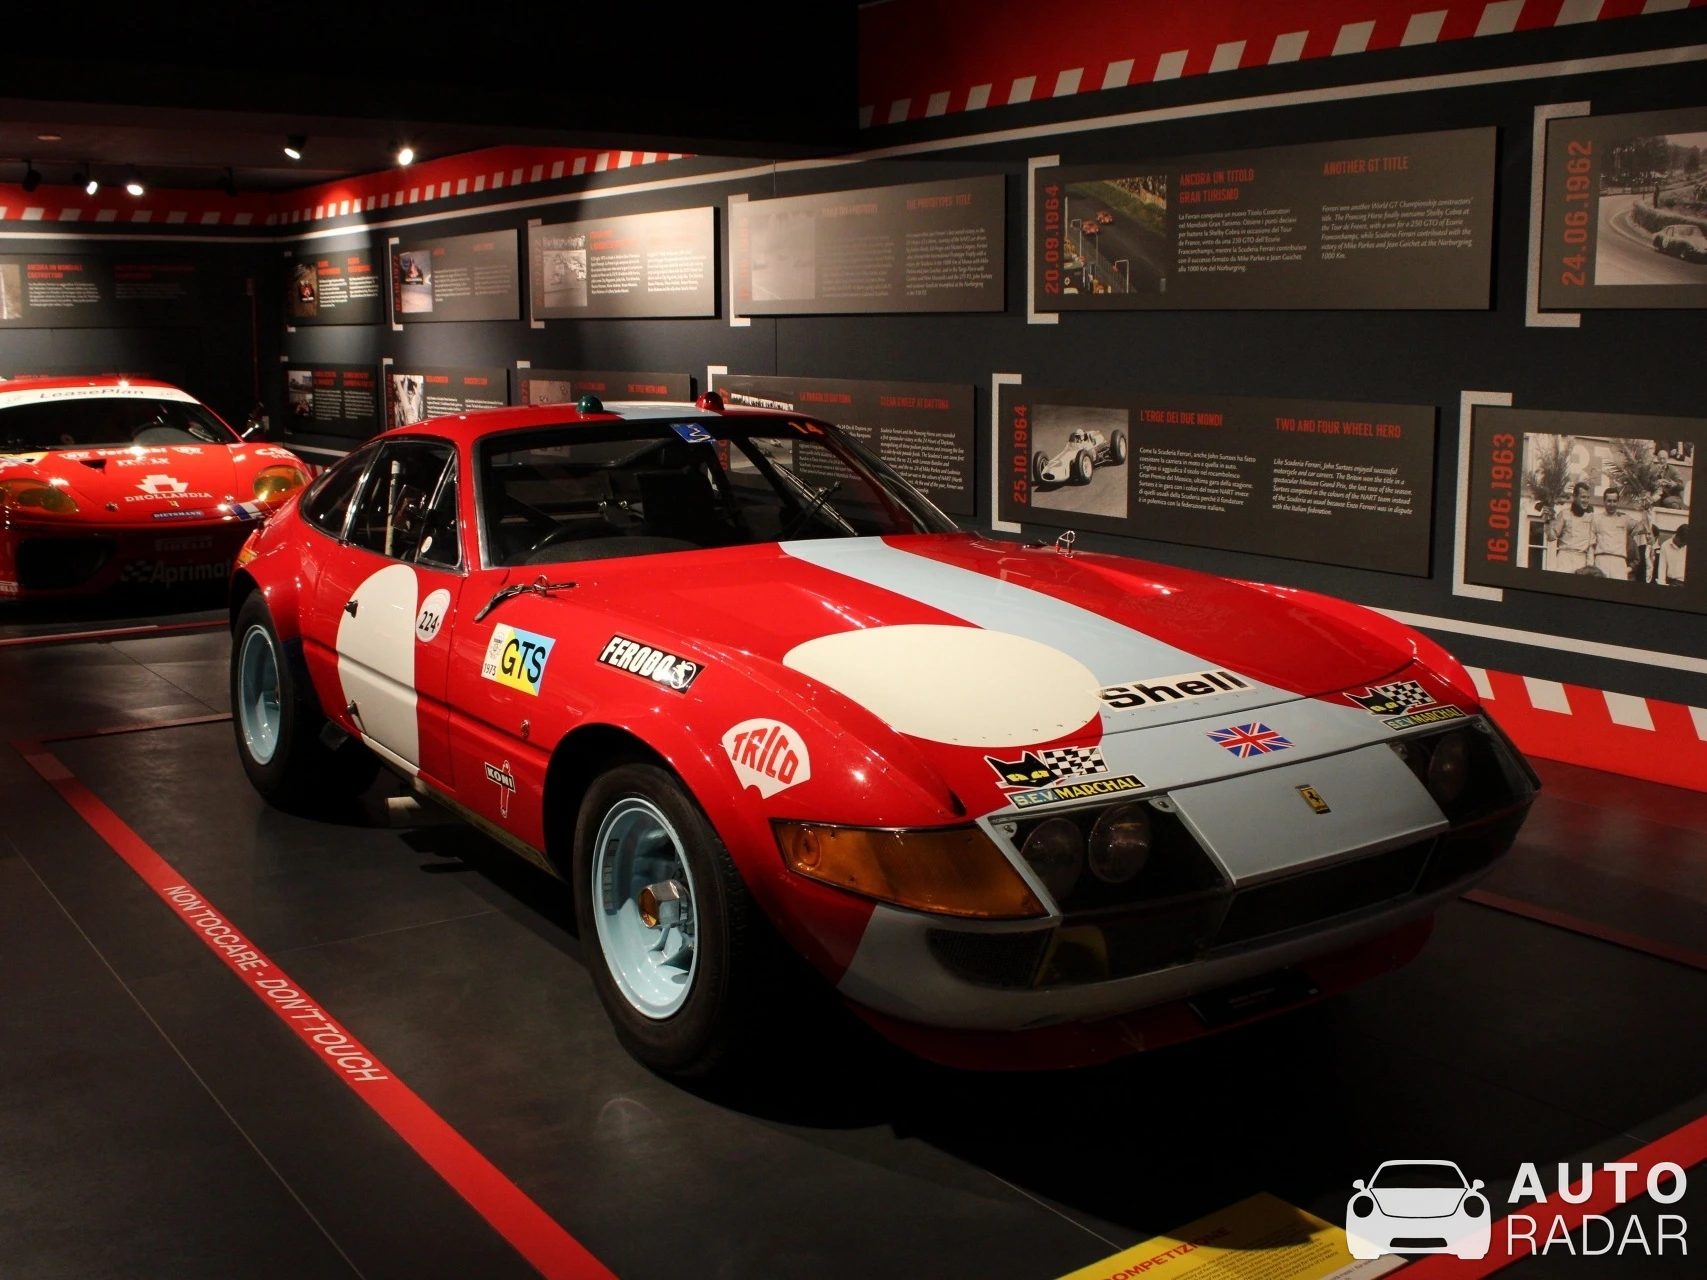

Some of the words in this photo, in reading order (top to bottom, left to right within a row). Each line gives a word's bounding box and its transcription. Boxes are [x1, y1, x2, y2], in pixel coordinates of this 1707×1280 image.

[1323, 160, 1366, 174] ANOTHER
[1368, 159, 1381, 172] GT
[1383, 156, 1409, 170] TITLE
[1179, 173, 1211, 186] ANCORA
[1213, 171, 1225, 184] UN
[1227, 169, 1255, 183] TITOLO
[956, 194, 972, 206] TITLE
[1179, 190, 1201, 203] GRAN
[1203, 188, 1239, 202] TURISMO
[1561, 140, 1593, 287] 24.06.1962
[1043, 183, 1061, 295] 20.09.1964
[40, 388, 144, 399] LeasePlan
[880, 395, 897, 407] CLEAN
[897, 397, 915, 408] SWEEP
[924, 399, 949, 410] DAYTONA
[1140, 410, 1164, 423] L'EROE
[1166, 411, 1179, 424] DEI
[1180, 412, 1195, 424] DUE
[1197, 413, 1223, 426] MONDI
[1275, 417, 1295, 431] TWO
[1297, 419, 1315, 432] AND
[1317, 420, 1340, 434] FOUR
[1343, 422, 1374, 437] WHEEL
[1376, 424, 1402, 439] HERO
[1012, 404, 1028, 505] 25.10.1964
[124, 491, 213, 503] DHOLLANDIA
[1486, 432, 1516, 563] 16.06.1963
[418, 610, 440, 633] 224
[483, 663, 497, 676] 1973
[501, 638, 546, 684] GTS
[1100, 670, 1247, 710] Shell
[1410, 707, 1464, 723] MARCHAL
[731, 725, 799, 785] TRICO
[487, 765, 515, 791] KONI
[1013, 790, 1058, 806] S.E.V.
[1054, 776, 1142, 800] MARCHAL
[163, 885, 206, 911] NON
[189, 909, 269, 970] TOCCARE
[255, 979, 326, 1022] DON'T
[303, 1022, 388, 1081] TOUCH
